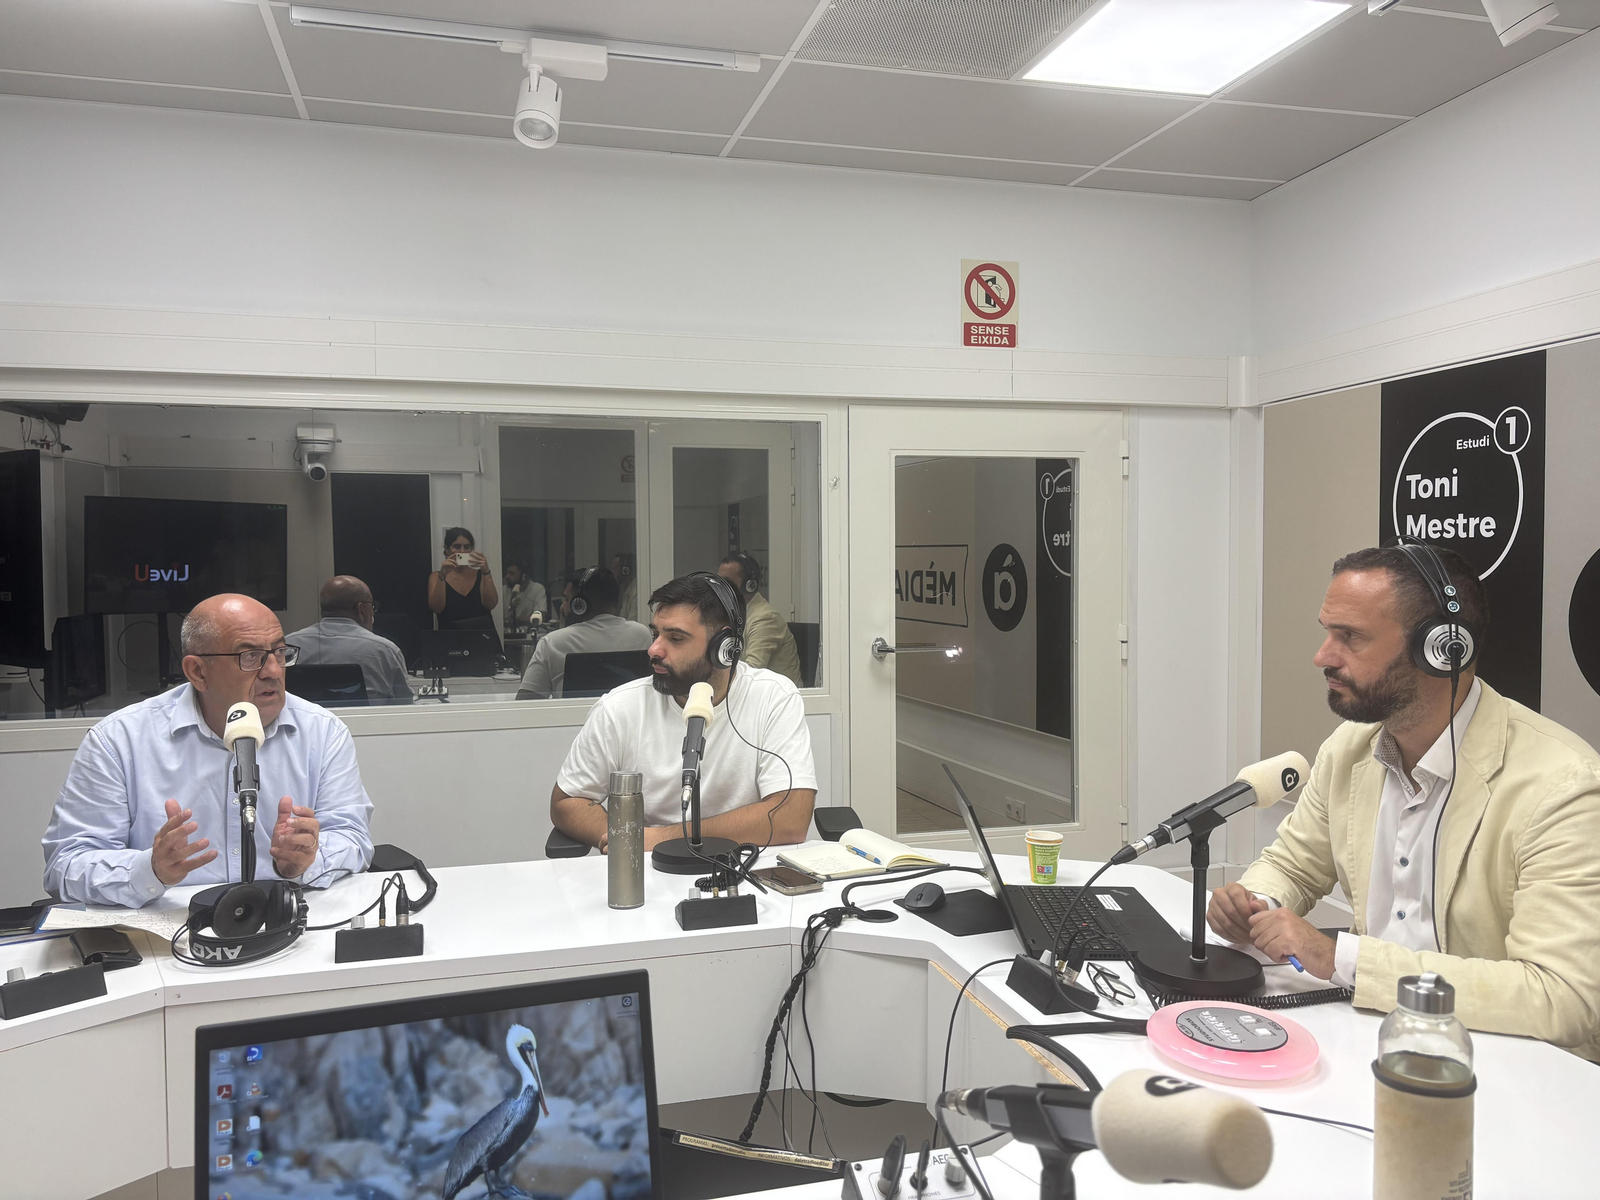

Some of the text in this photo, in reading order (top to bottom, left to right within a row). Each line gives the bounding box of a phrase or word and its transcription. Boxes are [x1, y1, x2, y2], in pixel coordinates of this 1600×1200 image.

[970, 325, 1010, 335] SENSE
[970, 335, 1010, 345] EIXIDA
[1456, 416, 1517, 450] Estudi 1
[1405, 467, 1458, 500] Toni
[1405, 513, 1497, 540] Mestre
[192, 942, 244, 961] AKG
[907, 1190, 942, 1200] HEAPHONES
